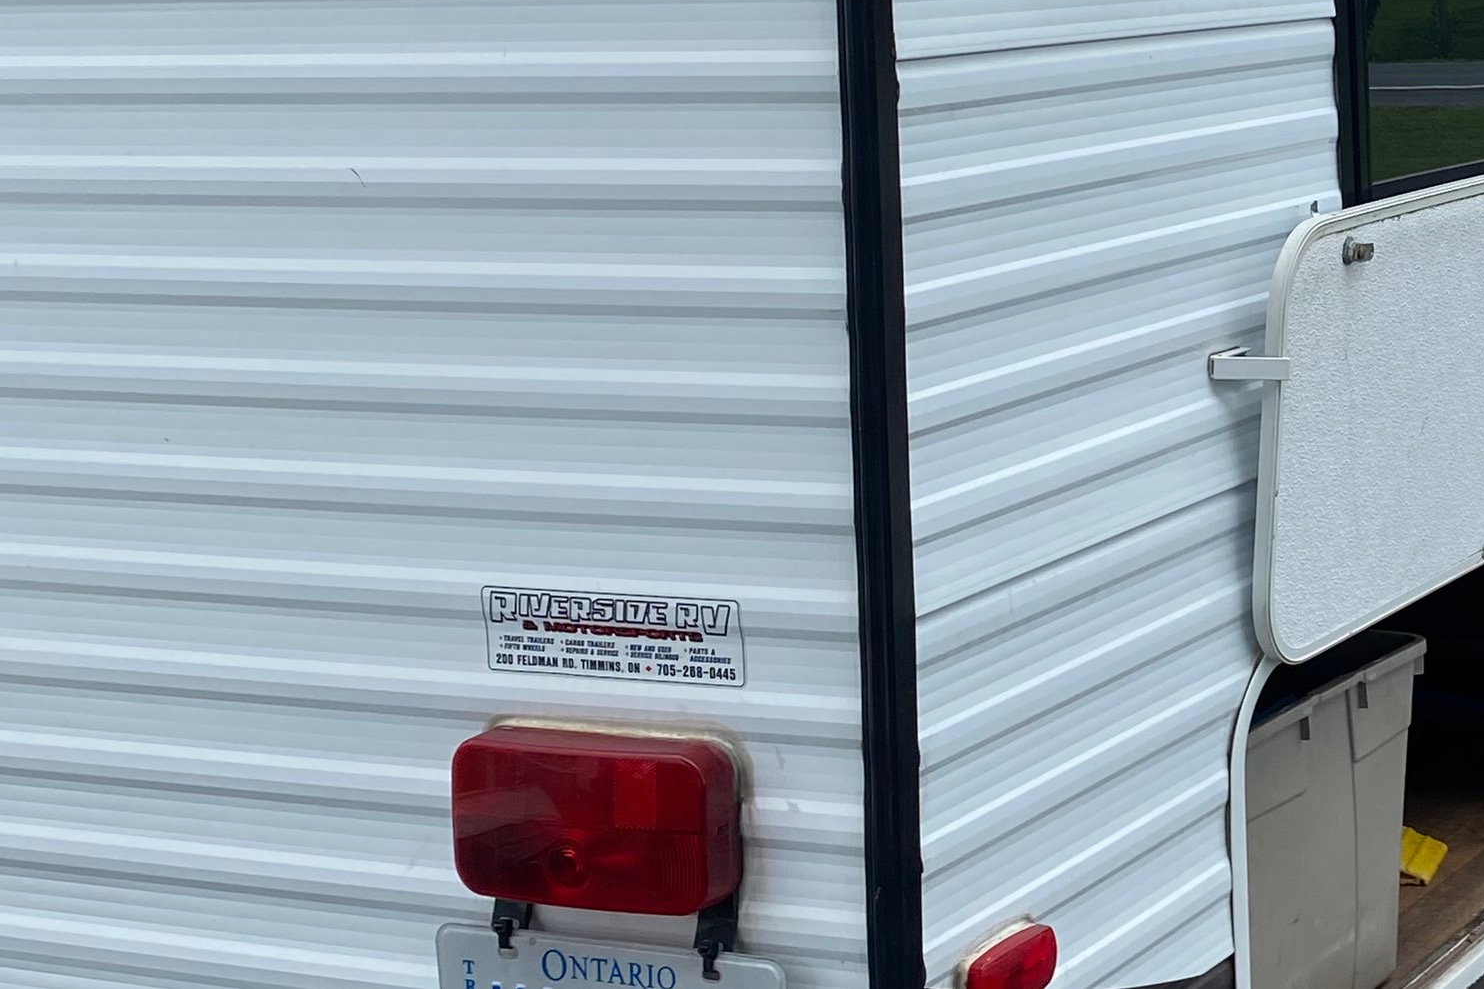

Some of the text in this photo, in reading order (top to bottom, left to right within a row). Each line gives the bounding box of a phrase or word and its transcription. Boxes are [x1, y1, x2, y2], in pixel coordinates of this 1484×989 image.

[490, 591, 730, 636] RIVERSIDE RV
[527, 636, 555, 645] TRAILERS
[587, 640, 615, 649] TRAILERS
[496, 653, 513, 665] 200
[517, 654, 558, 667] FELDMAN
[562, 657, 577, 669] RD.
[580, 659, 624, 673] TIMMINS,
[628, 662, 640, 673] ON
[541, 949, 676, 989] ONTARIO
